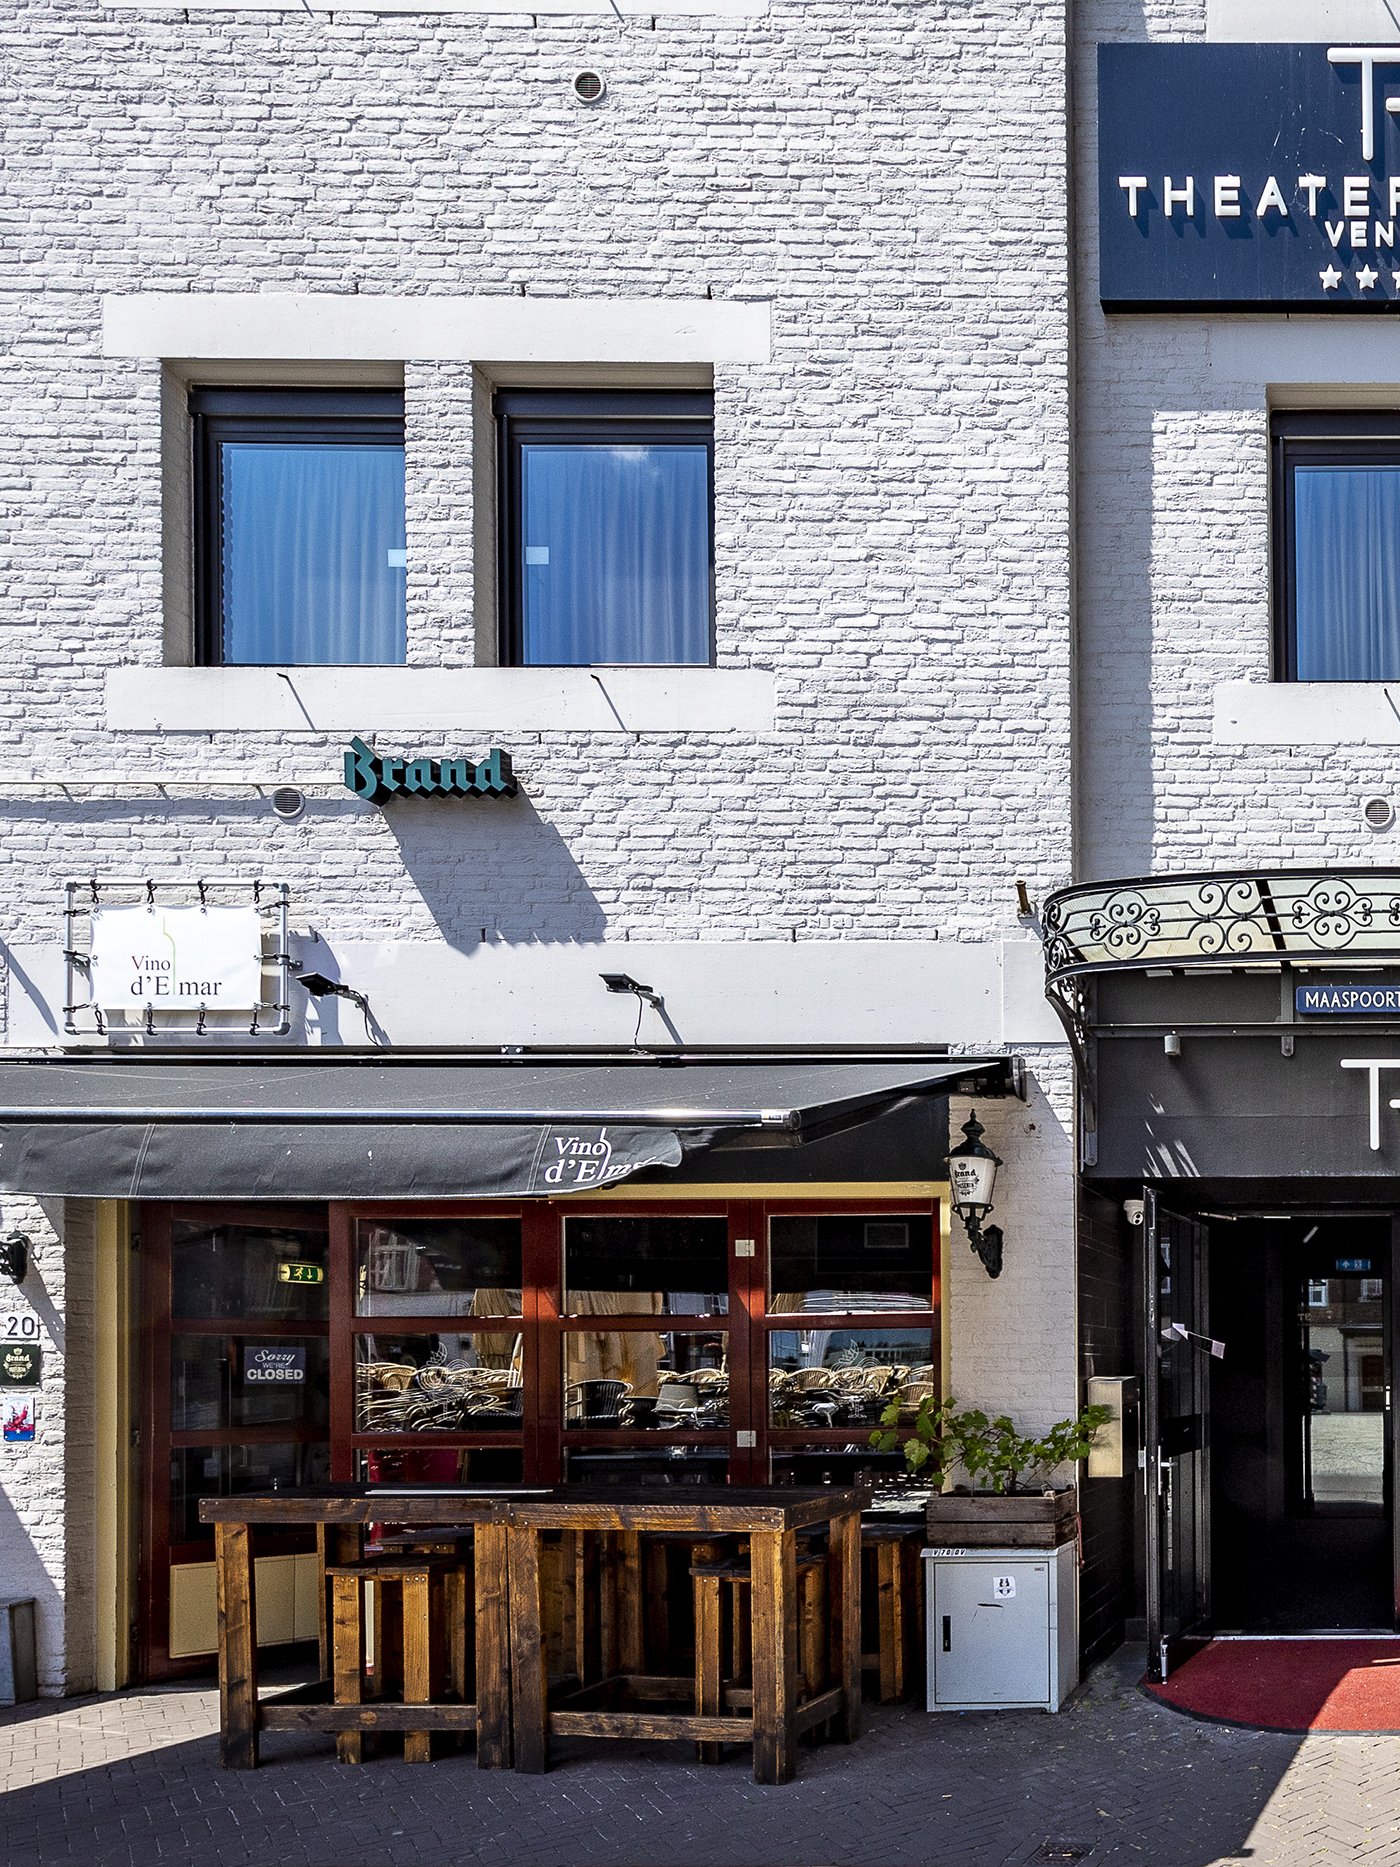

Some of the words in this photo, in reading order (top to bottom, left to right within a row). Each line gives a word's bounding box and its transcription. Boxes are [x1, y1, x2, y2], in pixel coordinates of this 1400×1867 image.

[343, 736, 514, 803] Brand
[131, 955, 171, 971] Vino
[554, 1136, 607, 1157] Vino
[7, 1316, 36, 1336] 20
[254, 1349, 296, 1366] Sorry
[246, 1368, 304, 1380] CLOSED
